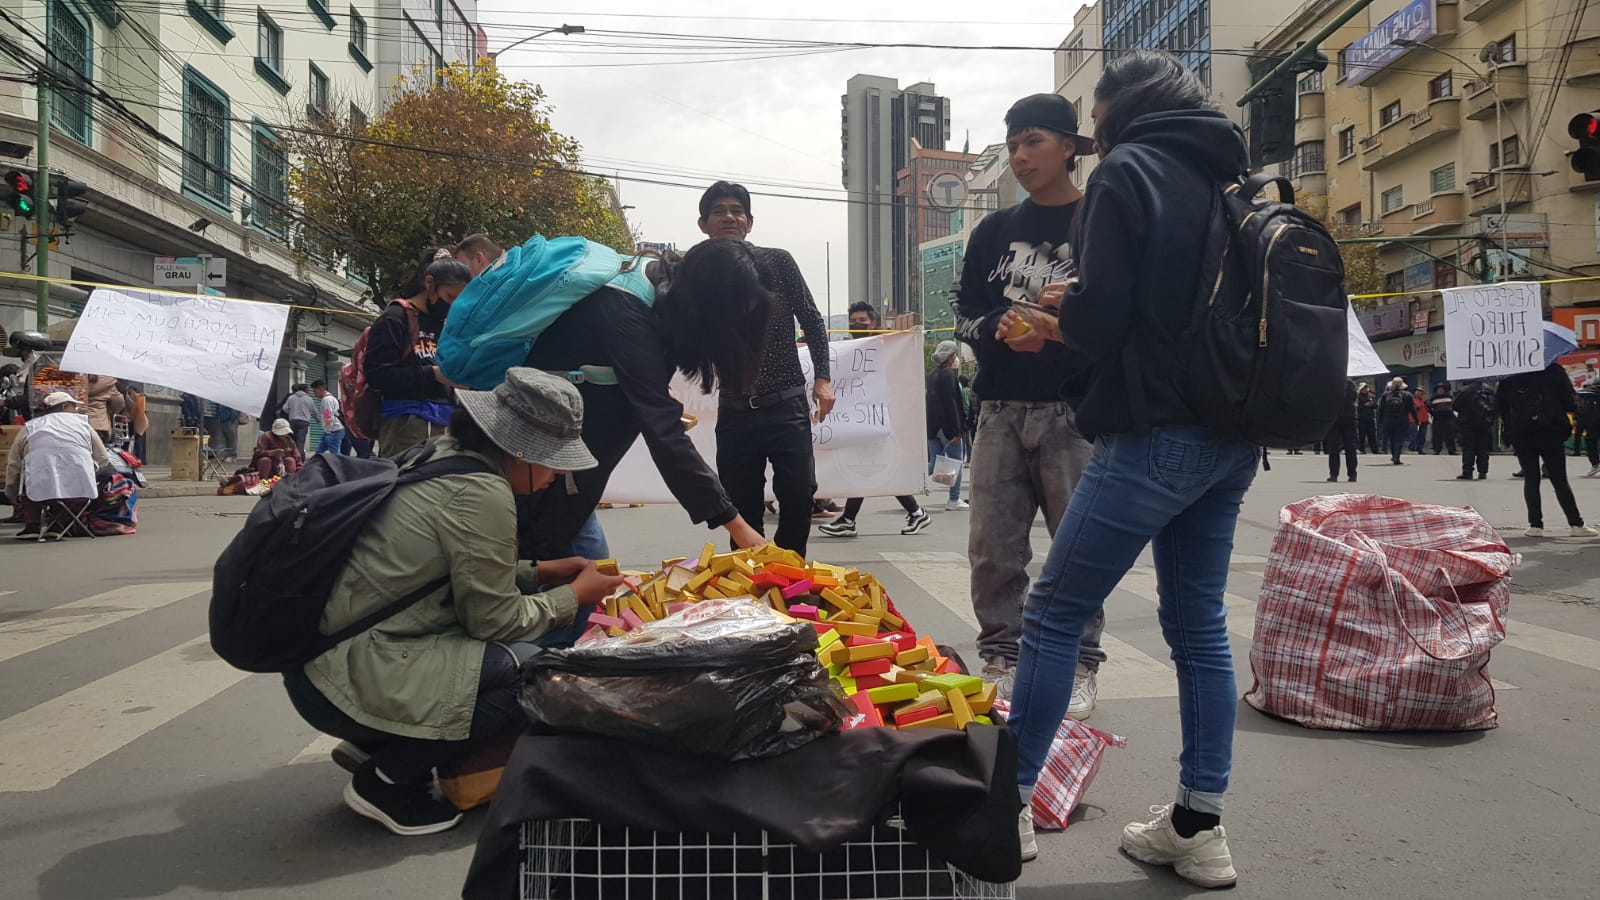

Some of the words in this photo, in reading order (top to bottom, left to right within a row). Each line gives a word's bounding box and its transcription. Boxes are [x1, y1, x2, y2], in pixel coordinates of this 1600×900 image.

[1363, 24, 1391, 60] CANAL
[164, 271, 192, 280] GRAU
[851, 348, 878, 373] DE
[854, 402, 885, 426] SIN
